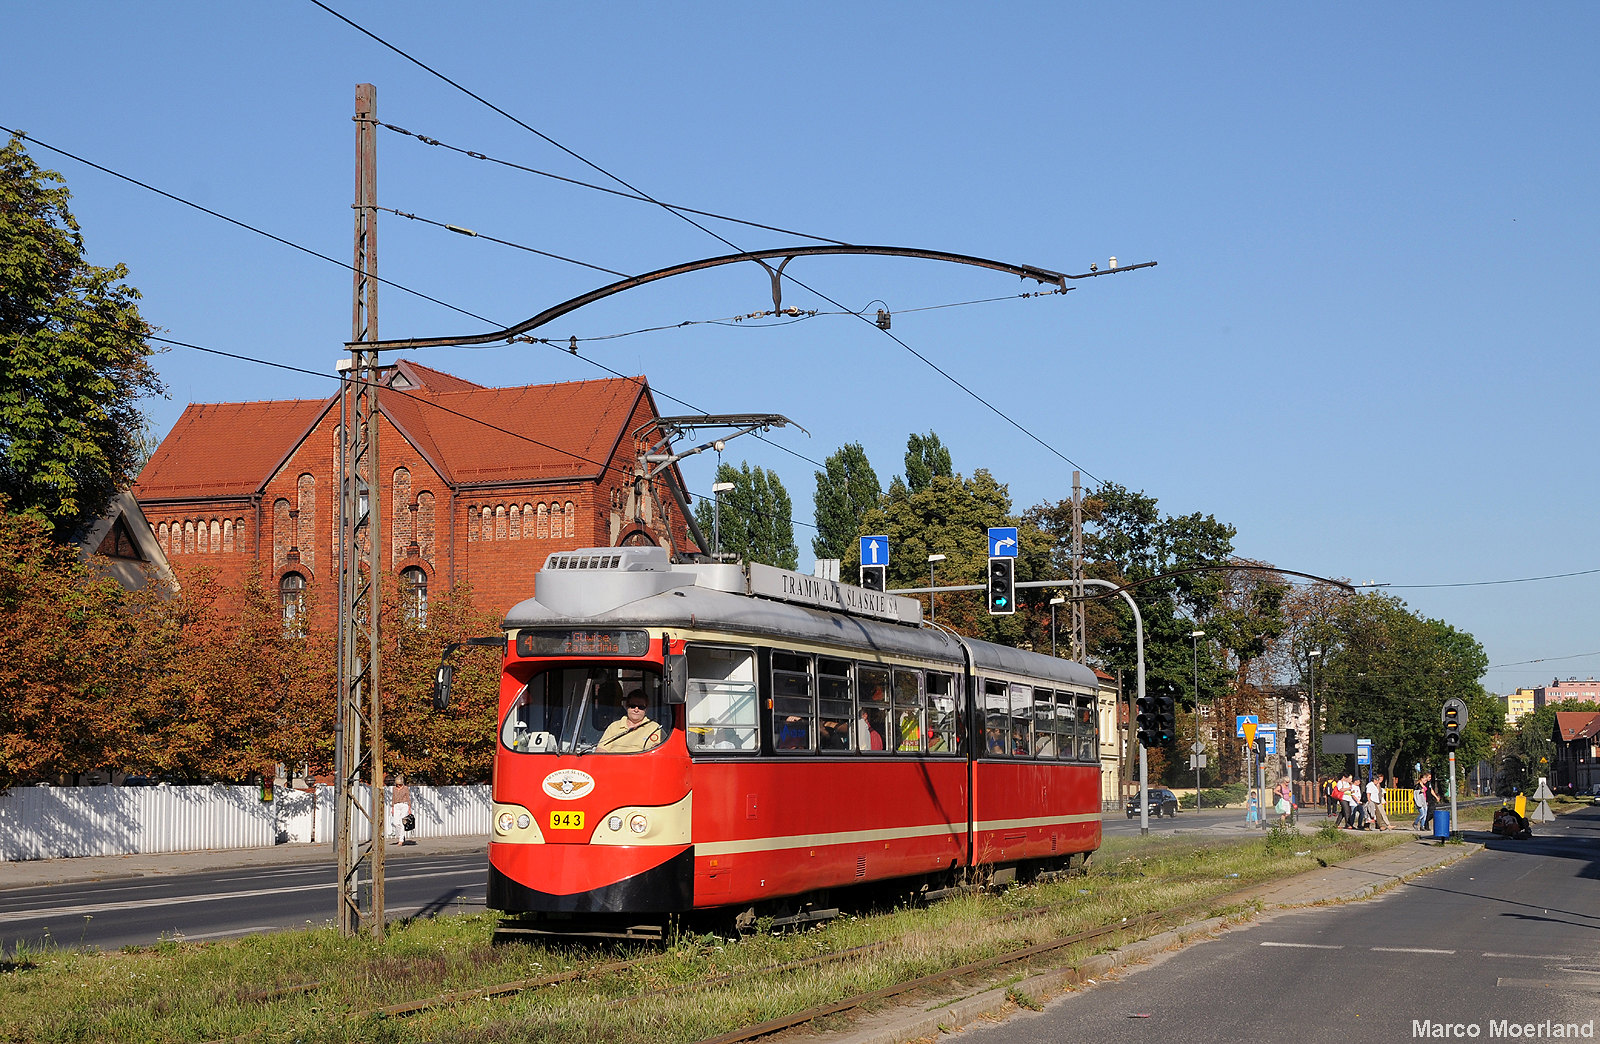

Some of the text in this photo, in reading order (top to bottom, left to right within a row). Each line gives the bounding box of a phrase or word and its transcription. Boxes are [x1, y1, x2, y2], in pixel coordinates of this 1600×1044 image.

[782, 575, 840, 604] TRAMWAJE
[524, 635, 533, 651] 4
[534, 733, 543, 745] 6
[553, 814, 581, 827] 943
